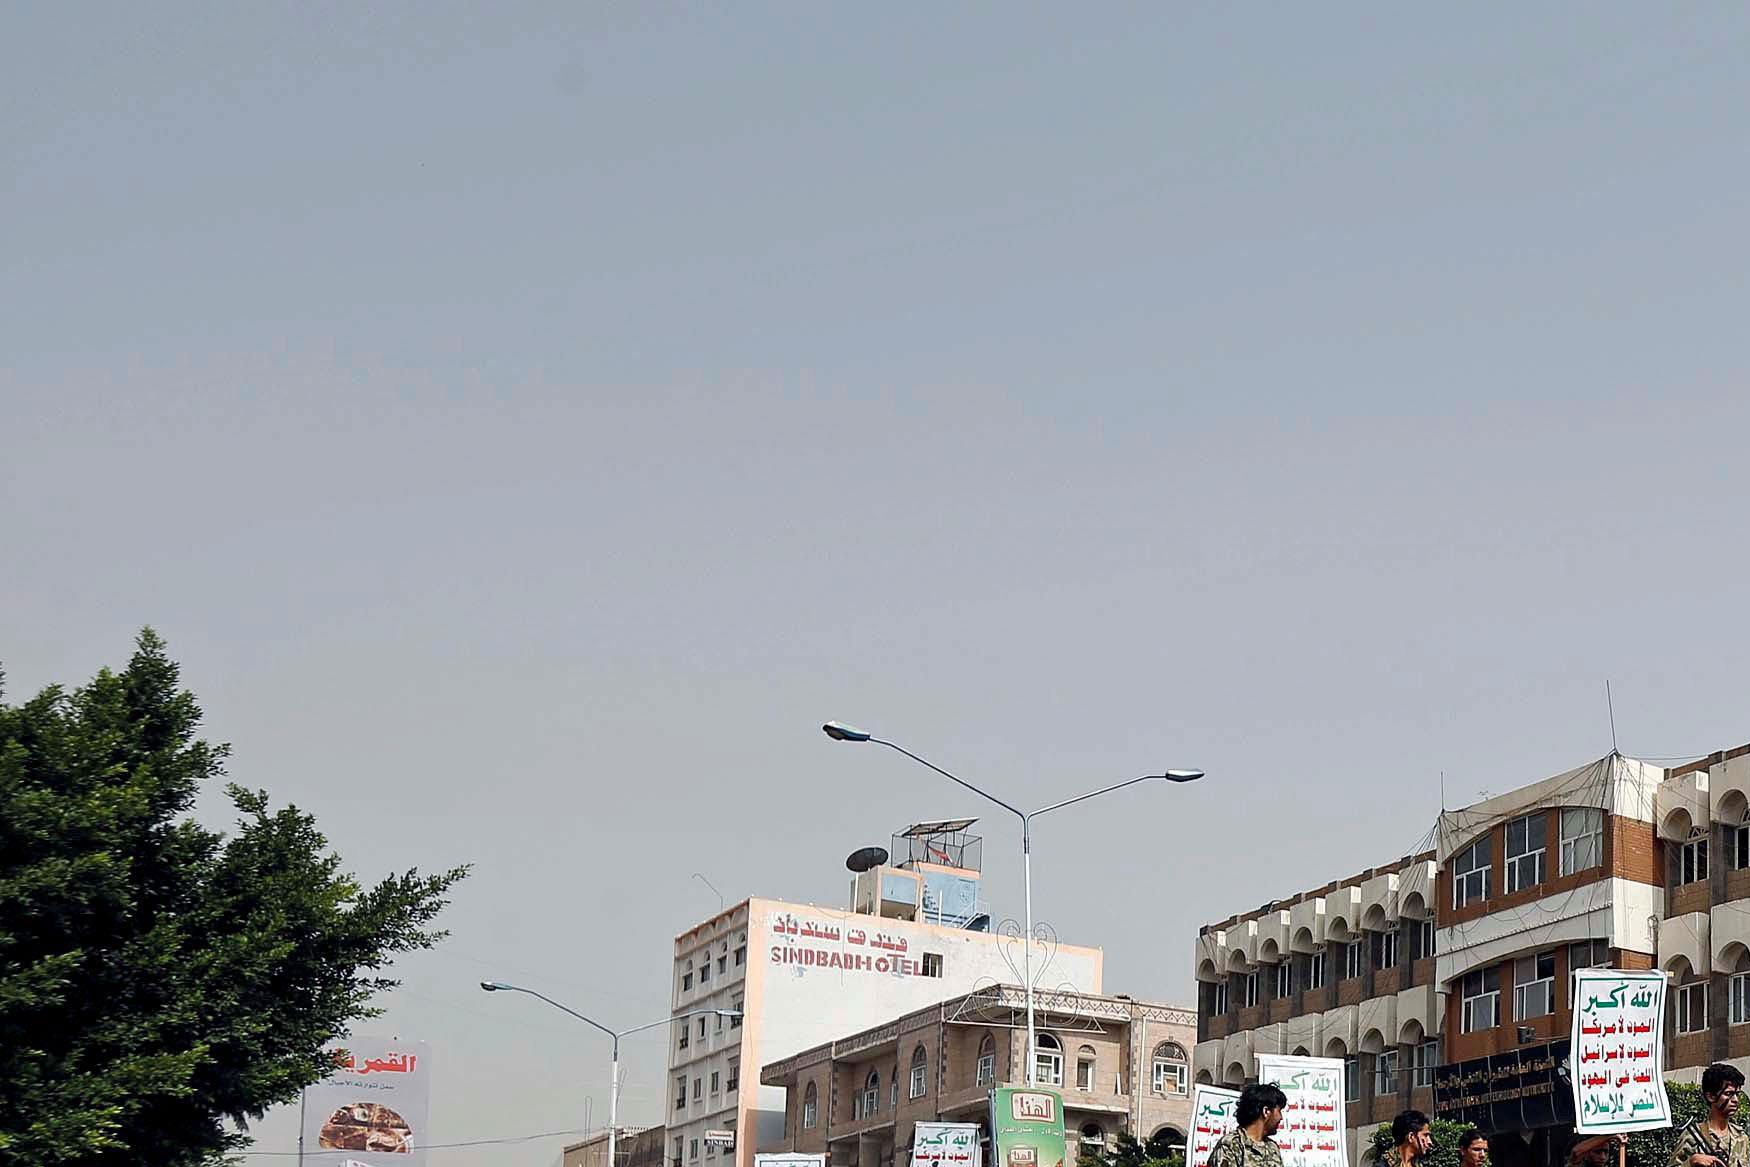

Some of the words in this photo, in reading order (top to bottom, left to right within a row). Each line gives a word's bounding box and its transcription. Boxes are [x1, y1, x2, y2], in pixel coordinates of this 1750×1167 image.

[1582, 981, 1628, 1015] أكبر
[1631, 984, 1658, 1008] الله
[1582, 1014, 1623, 1037] لأمريكا
[1627, 1018, 1654, 1036] الموت
[334, 1048, 416, 1074] القمرية
[1581, 1042, 1624, 1064] لإسرائيل
[1628, 1042, 1653, 1062] الموت
[1311, 1074, 1336, 1091] الله
[1582, 1070, 1611, 1088] اليهود
[1615, 1069, 1630, 1088] على
[1633, 1068, 1654, 1083] اللعنة
[1199, 1099, 1233, 1119] أكبر
[1309, 1101, 1337, 1113] الموت
[1583, 1091, 1623, 1120] للإسلام
[1629, 1088, 1658, 1116] النصر
[1310, 1119, 1337, 1133] الموت
[917, 1127, 952, 1148] أكبر
[952, 1132, 973, 1144] الله
[1300, 1139, 1312, 1152] على
[1317, 1138, 1338, 1150] اللعنة
[948, 1152, 972, 1161] الموت
